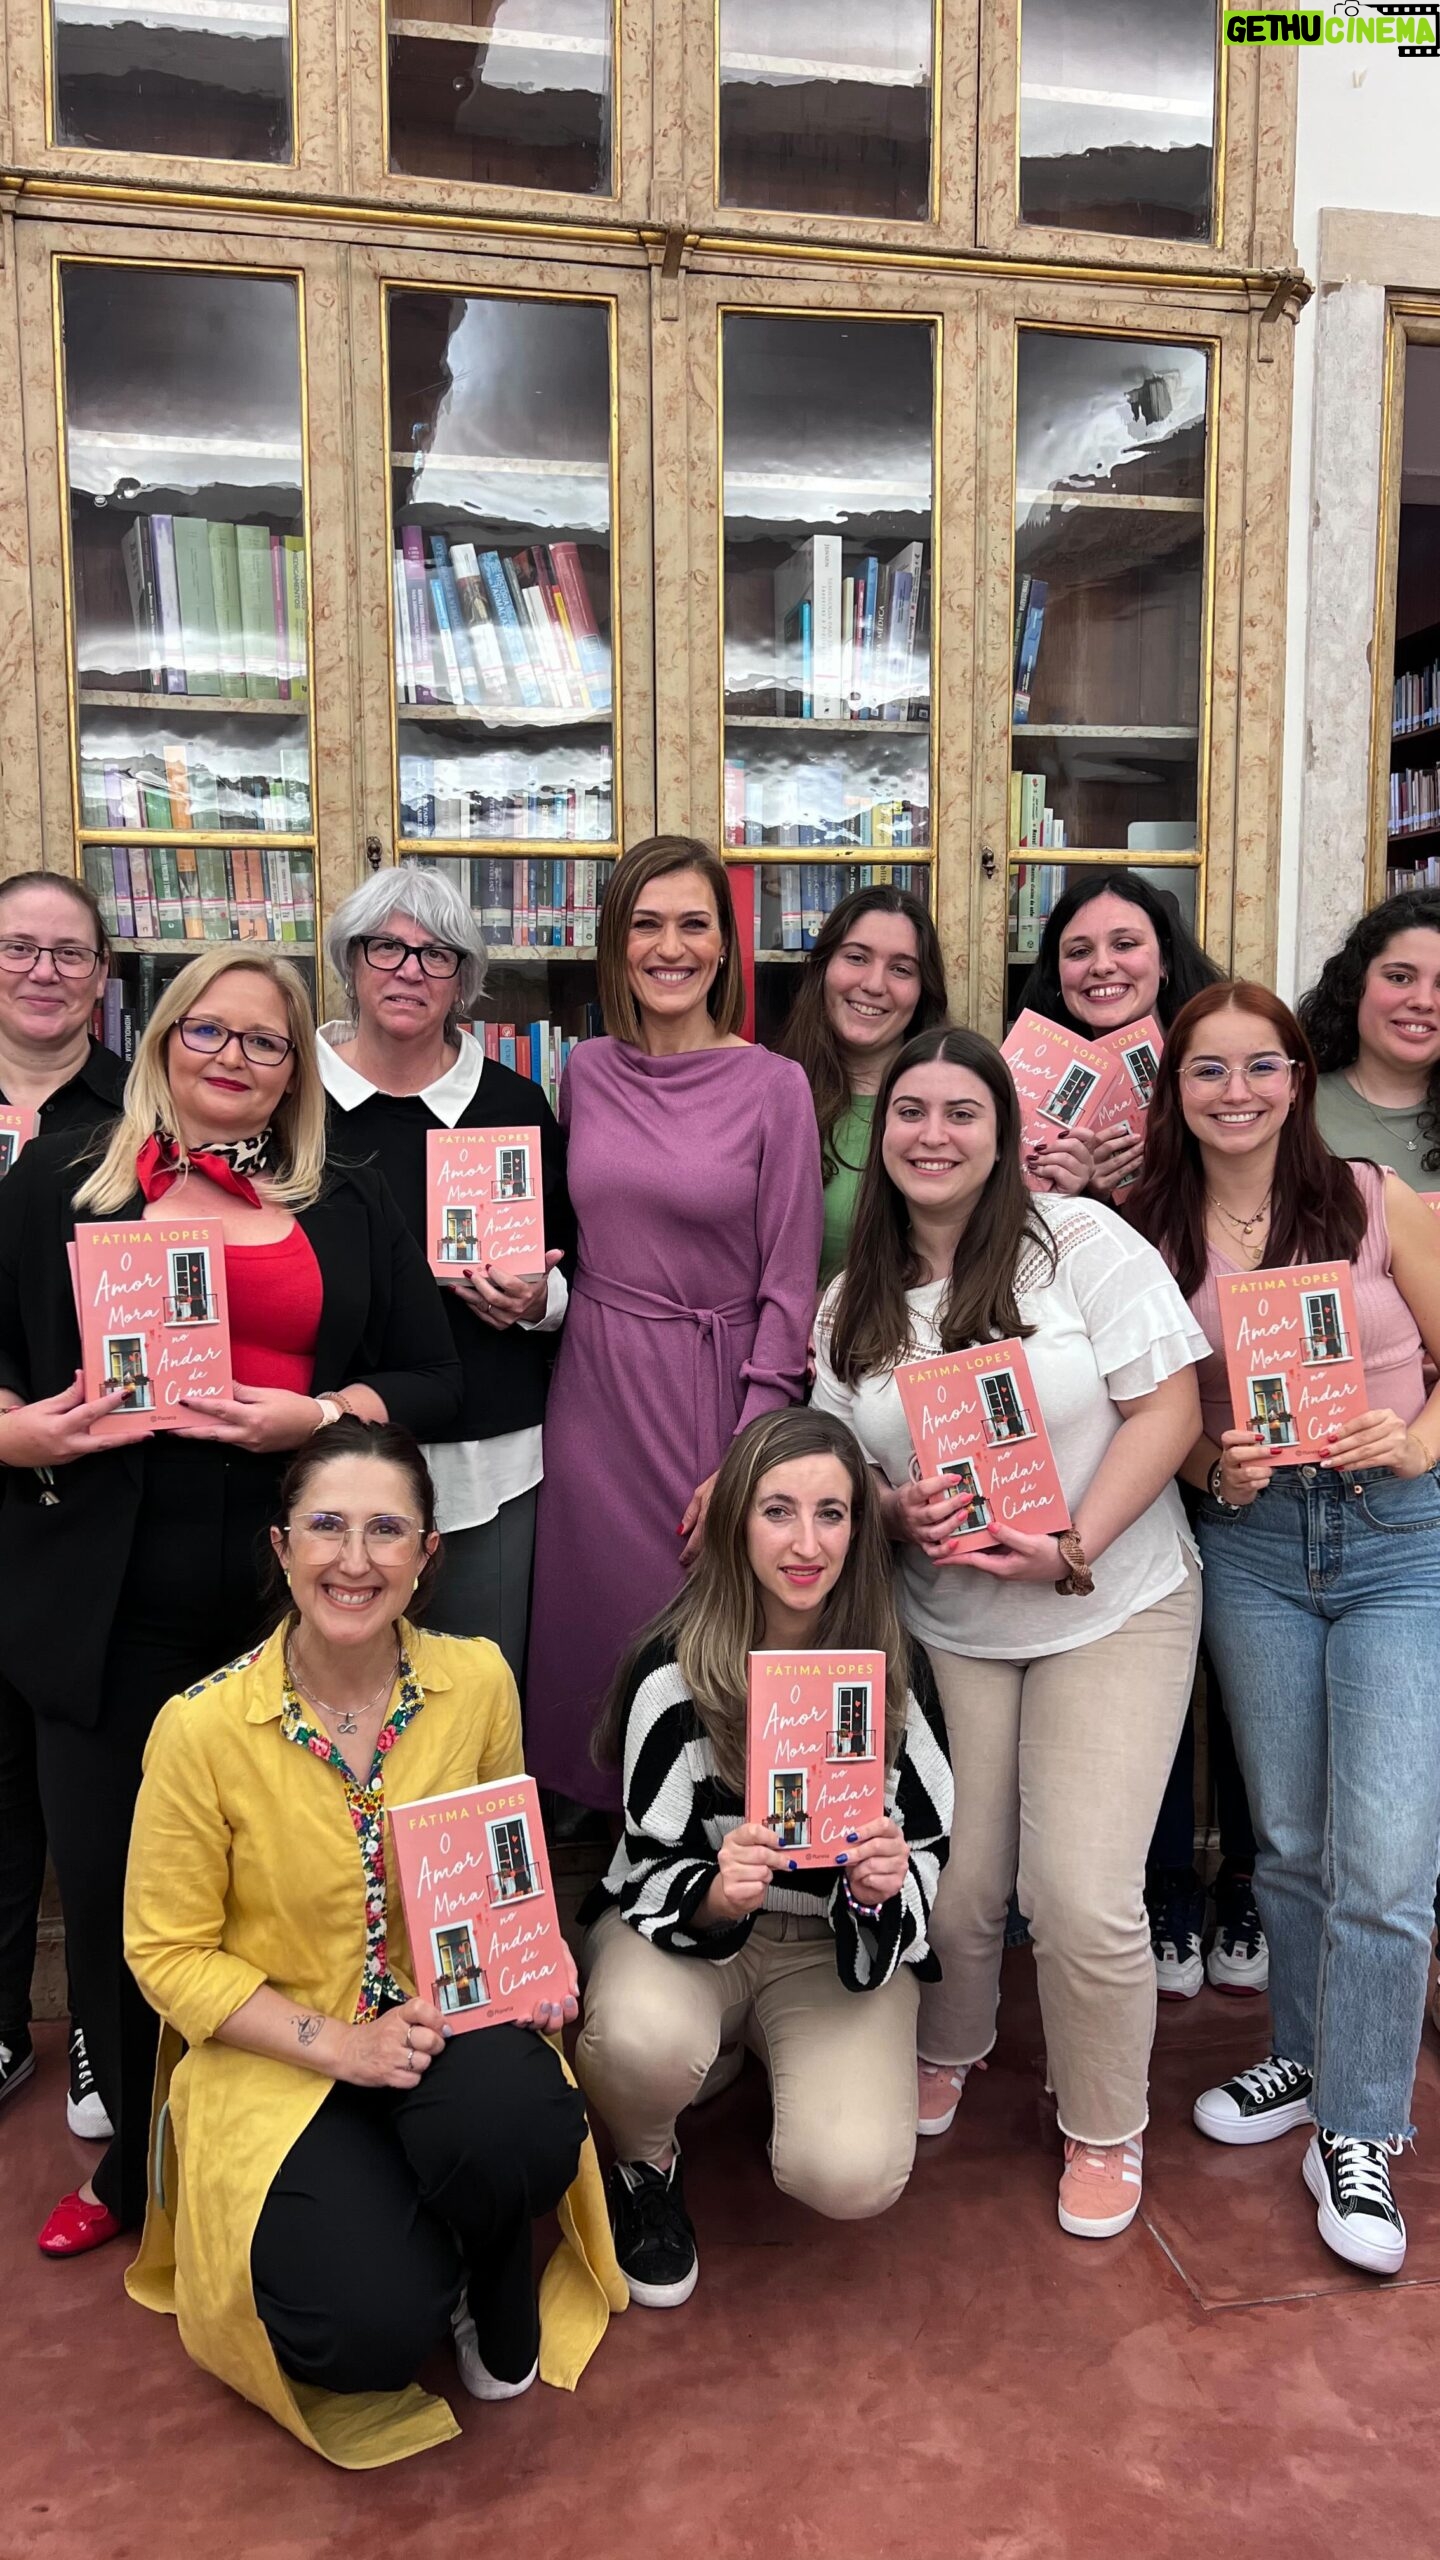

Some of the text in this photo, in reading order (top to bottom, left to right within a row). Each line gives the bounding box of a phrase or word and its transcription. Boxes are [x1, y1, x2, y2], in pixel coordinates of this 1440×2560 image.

[1027, 1021, 1108, 1070] FÁTIMA LOPES
[1112, 1028, 1148, 1049] LOPES
[1035, 1044, 1046, 1057] O
[1007, 1048, 1058, 1079] Amor
[439, 1133, 529, 1143] FÁTIMA LOPES
[460, 1148, 468, 1161] O
[437, 1160, 492, 1185] Amor
[447, 1186, 488, 1202] Mora
[497, 1207, 511, 1215] no
[484, 1216, 536, 1237] Andar
[509, 1232, 525, 1241] de
[92, 1230, 209, 1245] FÁTIMA LOPES
[489, 1241, 538, 1260] Cima
[120, 1252, 132, 1271] O
[94, 1270, 162, 1307] Amor
[1232, 1271, 1339, 1294] FÁTIMA LOPES
[108, 1306, 160, 1330] Mora
[1258, 1299, 1268, 1316] O
[172, 1332, 190, 1344] no
[1236, 1316, 1298, 1351] Amor
[157, 1348, 222, 1376] Andar
[909, 1351, 1011, 1384] FÁTIMA LOPES
[1251, 1349, 1298, 1371] Mora
[188, 1369, 208, 1381] de
[1310, 1371, 1326, 1381] no
[165, 1382, 224, 1405] Cima
[937, 1385, 946, 1403] O
[1298, 1384, 1357, 1412] Andar
[922, 1400, 977, 1440] Amor
[1328, 1403, 1345, 1416] de
[1307, 1416, 1342, 1440] Cim
[938, 1432, 980, 1459] Mora
[997, 1450, 1012, 1462] no
[990, 1459, 1045, 1494] Andar
[1021, 1482, 1036, 1495] de
[1002, 1494, 1055, 1520] Cima
[766, 1664, 873, 1676] FÁTIMA LOPES
[791, 1684, 800, 1704] O
[763, 1702, 827, 1739] Amor
[775, 1740, 823, 1764] Mora
[831, 1769, 848, 1780] no
[815, 1784, 876, 1812] Andar
[408, 1794, 526, 1831] FÁTIMA LOPES
[844, 1805, 860, 1819] de
[820, 1818, 857, 1844] Cim
[440, 1833, 450, 1854] O
[417, 1851, 483, 1898] Amor
[434, 1889, 484, 1921] Mora
[500, 1911, 517, 1924] no
[488, 1923, 550, 1964] Andar
[521, 1948, 538, 1964] de
[499, 1962, 557, 1996] Cima
